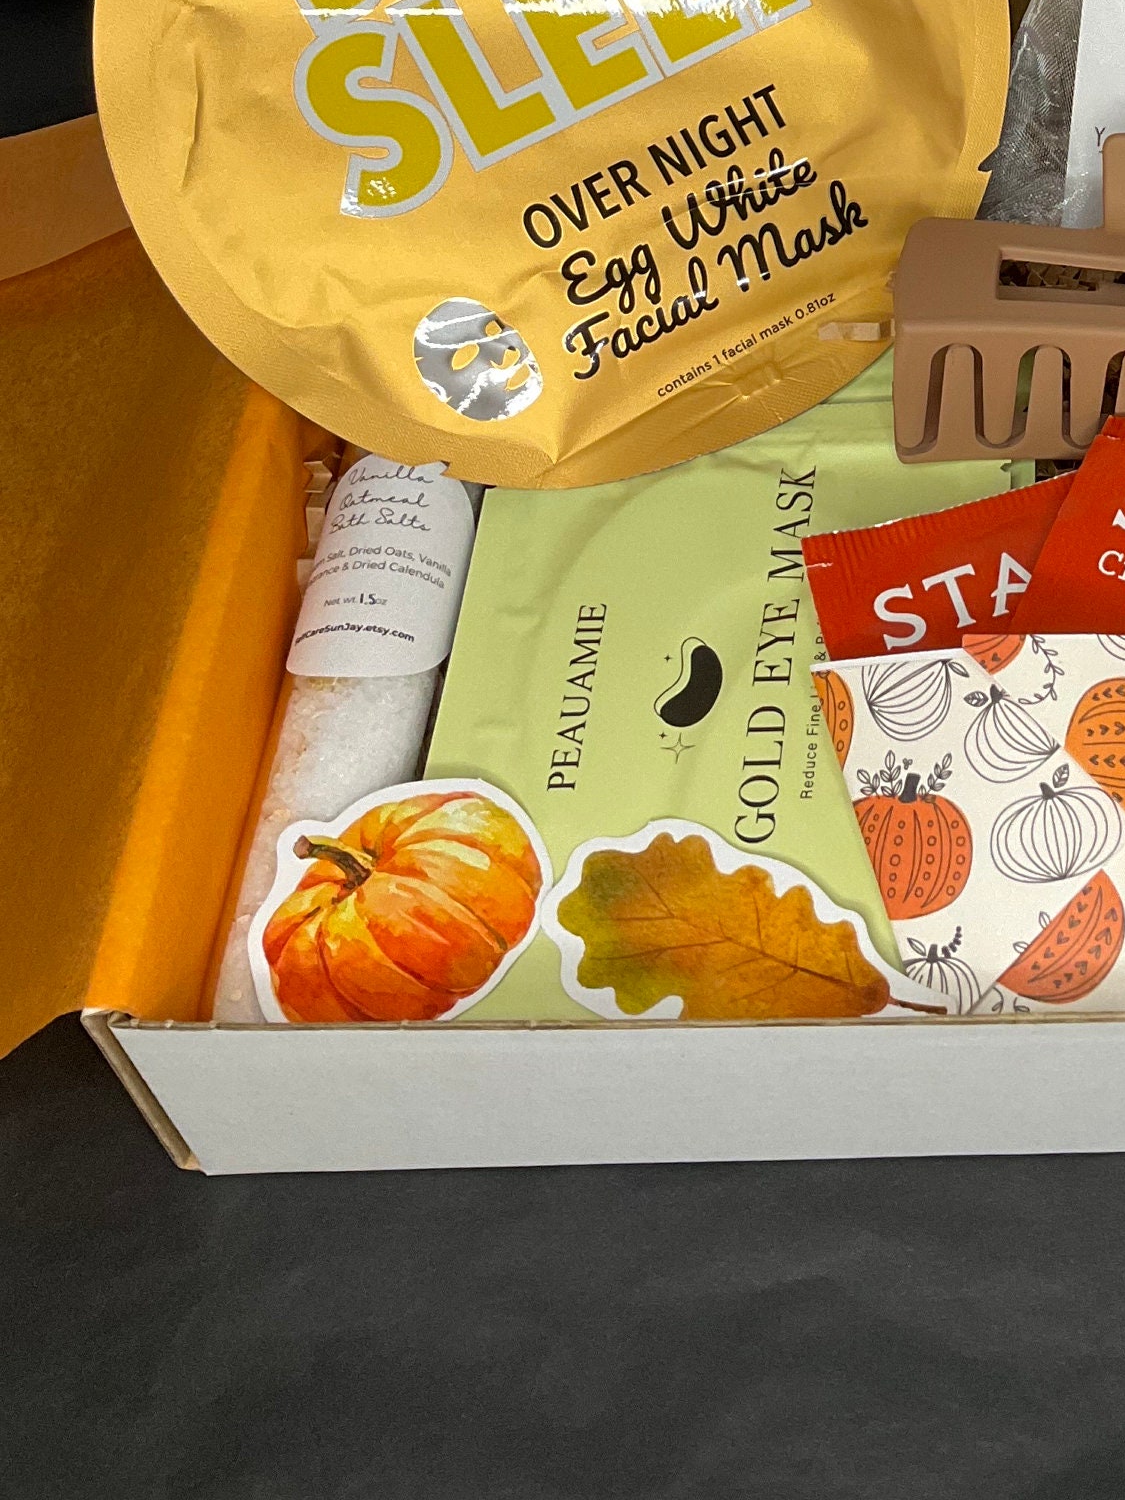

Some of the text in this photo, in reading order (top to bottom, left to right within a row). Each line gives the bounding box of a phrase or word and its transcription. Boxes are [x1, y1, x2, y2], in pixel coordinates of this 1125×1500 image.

[522, 84, 788, 250] OVER NIGHT
[560, 147, 818, 314] Egg White
[563, 179, 869, 381] Facial Mask
[657, 362, 713, 397] contains
[721, 334, 758, 360] facial
[759, 315, 794, 340] mask
[795, 292, 837, 320] 0.81oz
[348, 545, 383, 557] Dried
[352, 560, 387, 571] Dried
[388, 562, 445, 589] Calendula
[547, 601, 608, 792] PEAUAMIE
[733, 464, 817, 844] GOLD EYE MASK
[806, 704, 822, 736] Fine
[800, 741, 818, 799] Reduce
